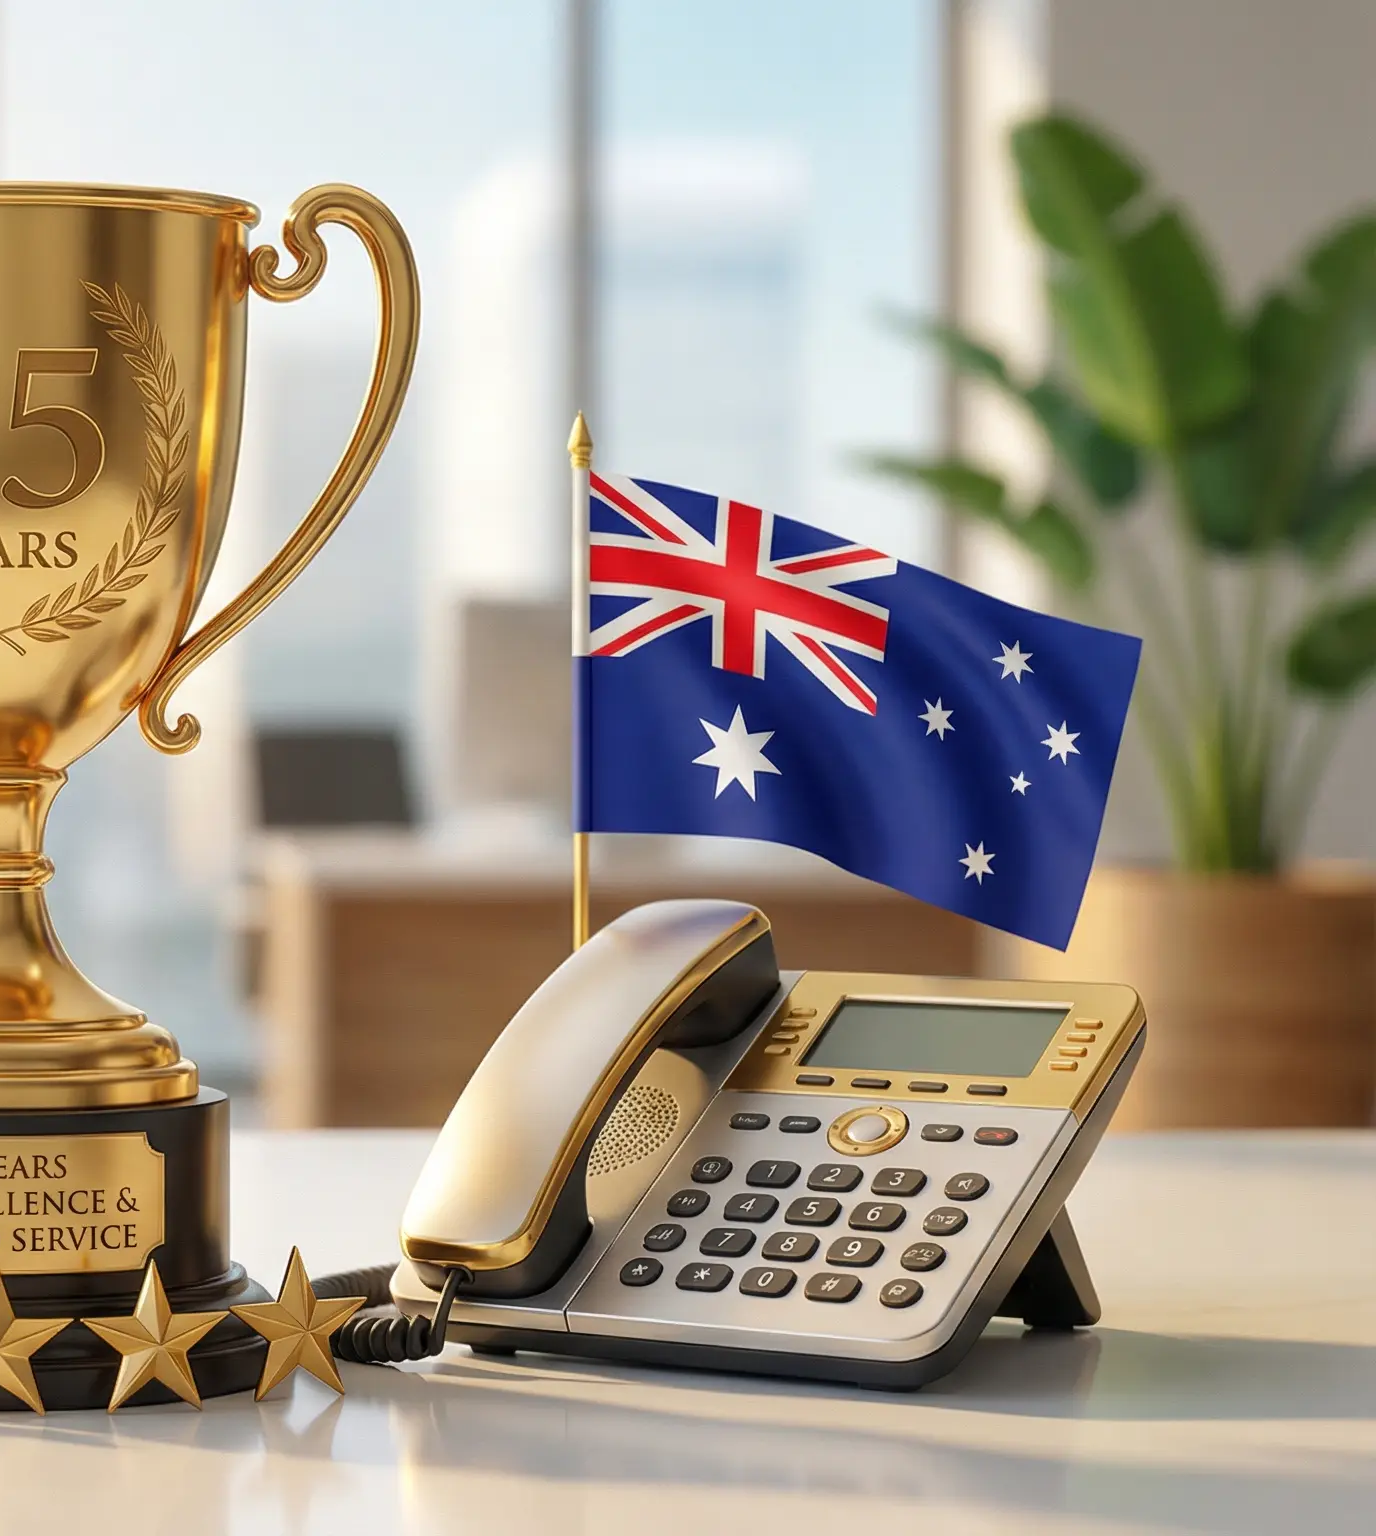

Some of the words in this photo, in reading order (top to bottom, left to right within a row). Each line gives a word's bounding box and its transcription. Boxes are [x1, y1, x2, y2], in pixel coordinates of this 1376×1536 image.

[767, 1164, 778, 1178] 1
[822, 1167, 842, 1183] 2
[888, 1171, 906, 1186] 3
[116, 1186, 141, 1213] &
[739, 1197, 757, 1212] 4
[802, 1201, 820, 1216] 5
[866, 1205, 884, 1222] 6
[11, 1223, 138, 1253] SERVICE
[717, 1232, 736, 1247] 7
[779, 1236, 798, 1252] 8
[842, 1240, 862, 1258] 9
[757, 1271, 775, 1287] 0
